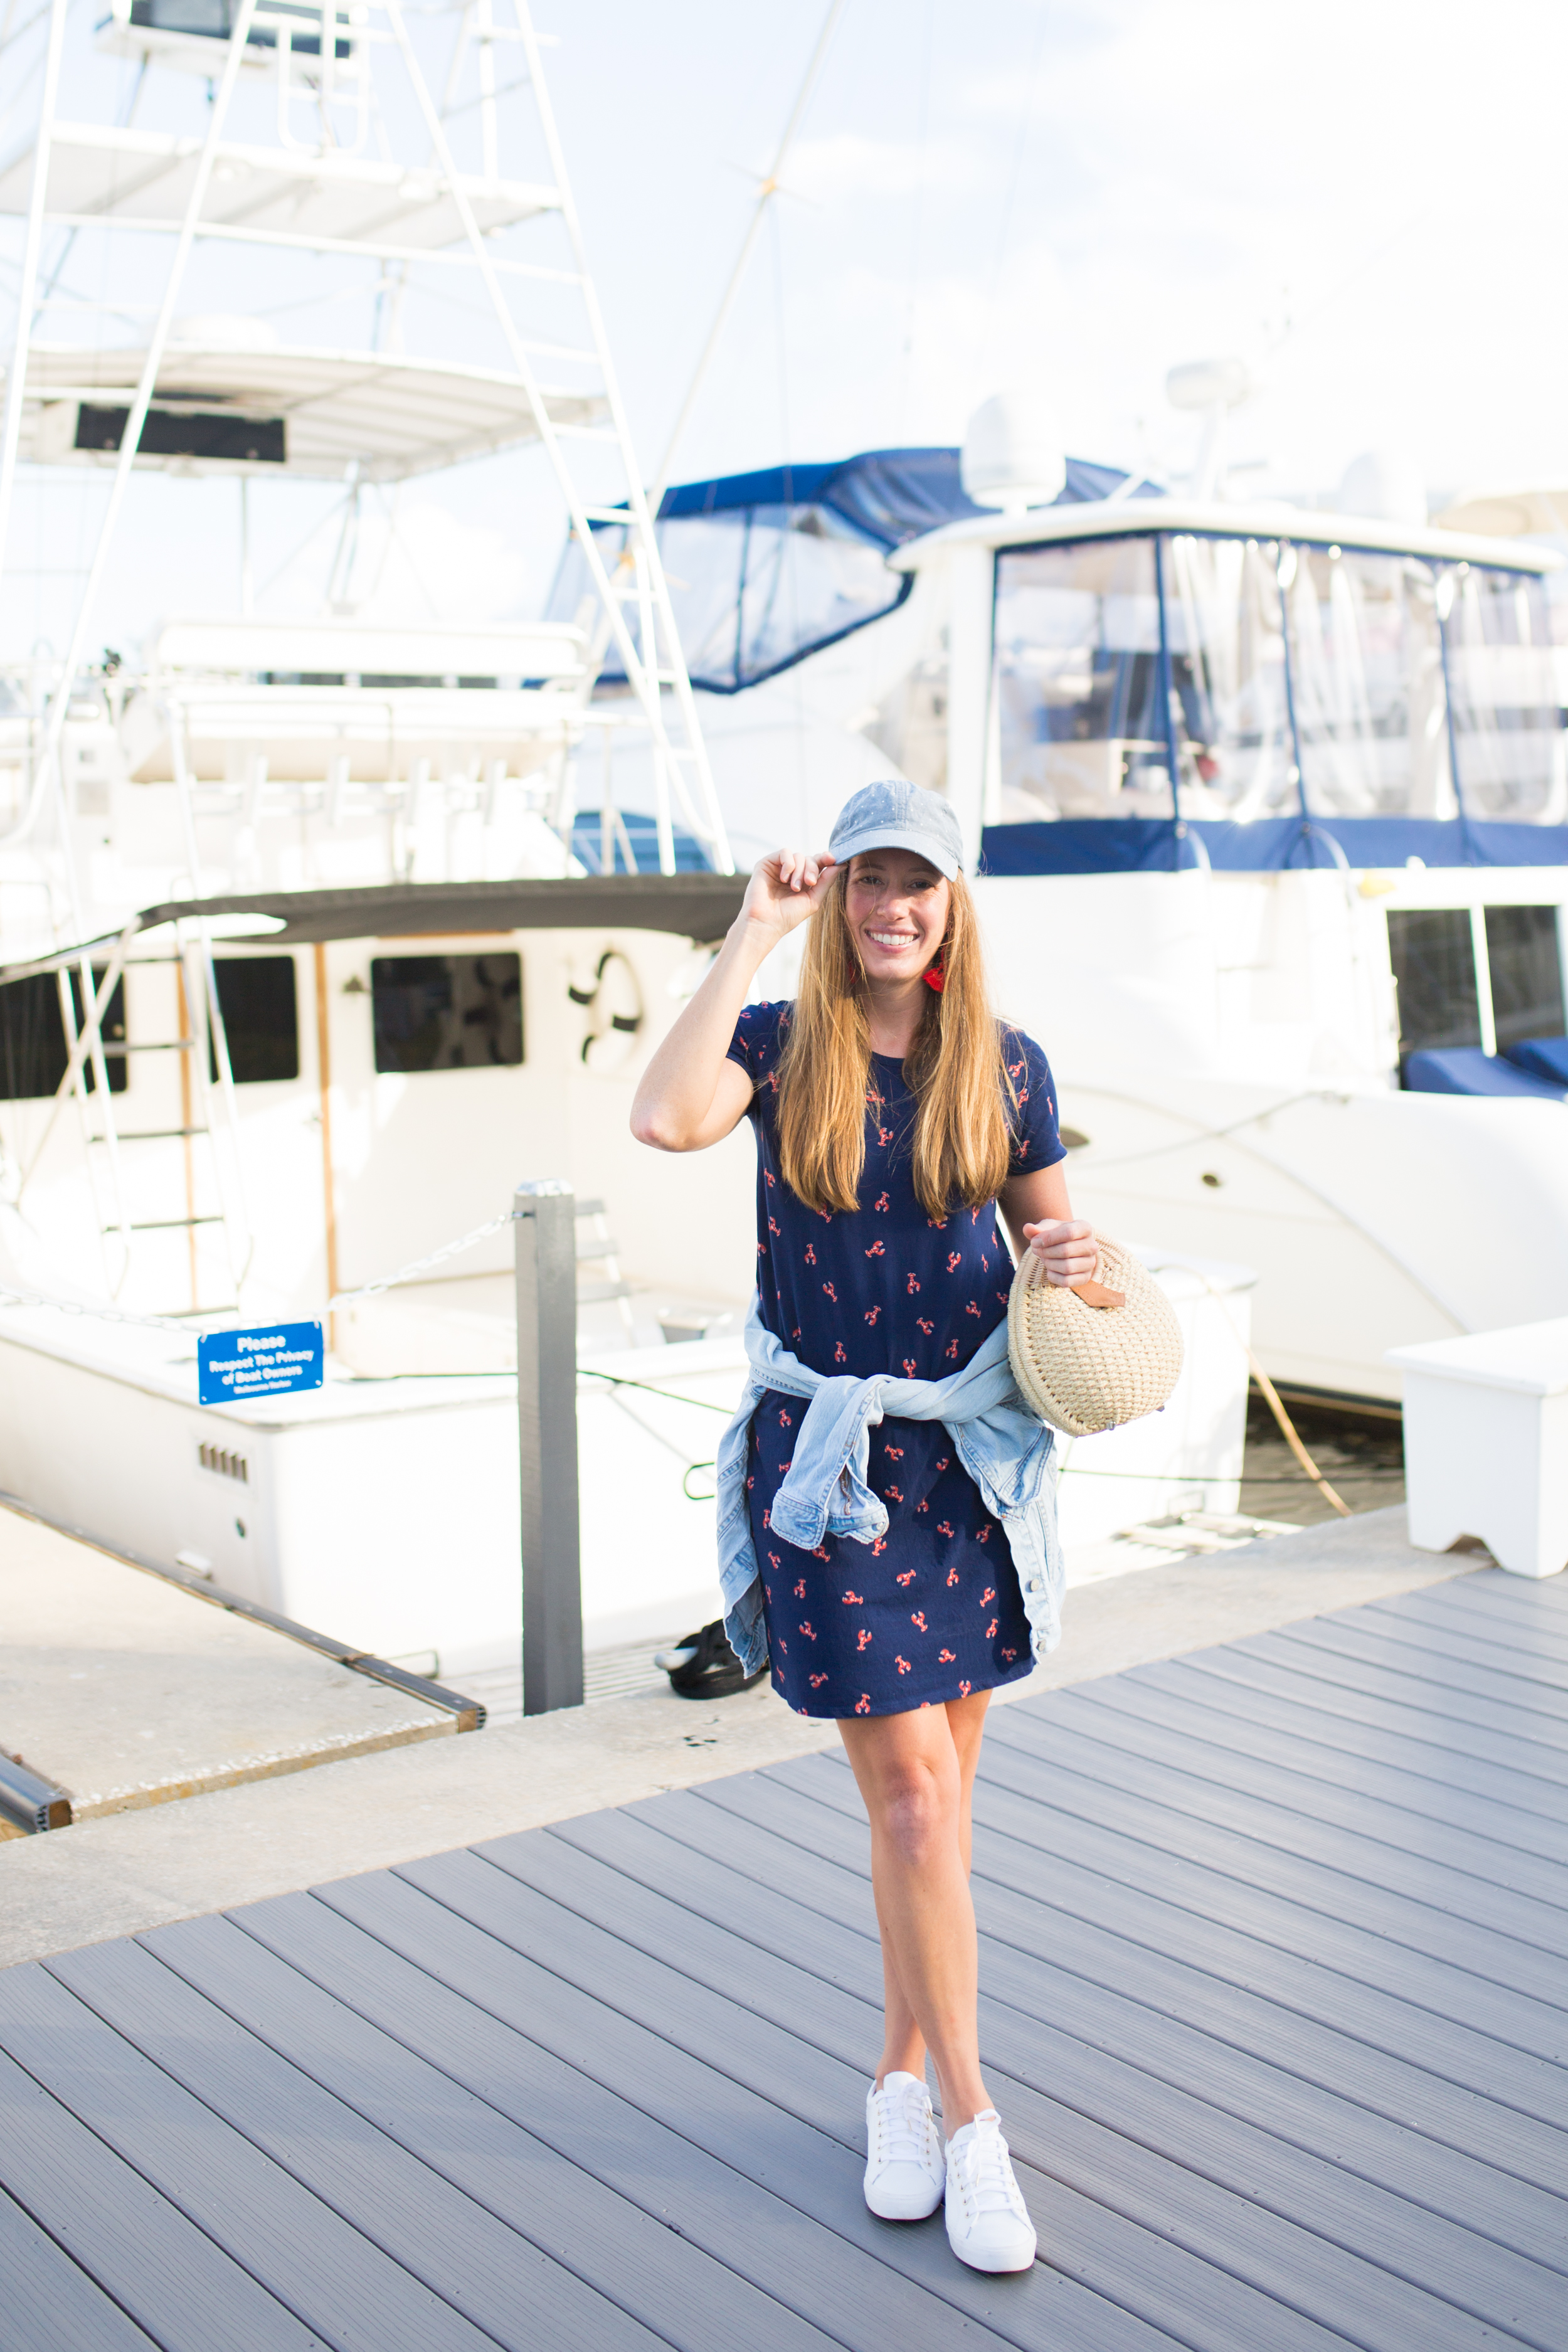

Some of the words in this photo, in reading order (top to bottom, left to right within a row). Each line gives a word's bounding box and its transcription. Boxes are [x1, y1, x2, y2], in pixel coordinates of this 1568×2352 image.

[237, 1335, 286, 1353] Please
[209, 1357, 254, 1372] Respect
[254, 1355, 275, 1367] The
[275, 1350, 314, 1364] Privacy
[222, 1372, 235, 1385] of
[235, 1369, 262, 1383] Boat
[262, 1365, 303, 1379] Owners
